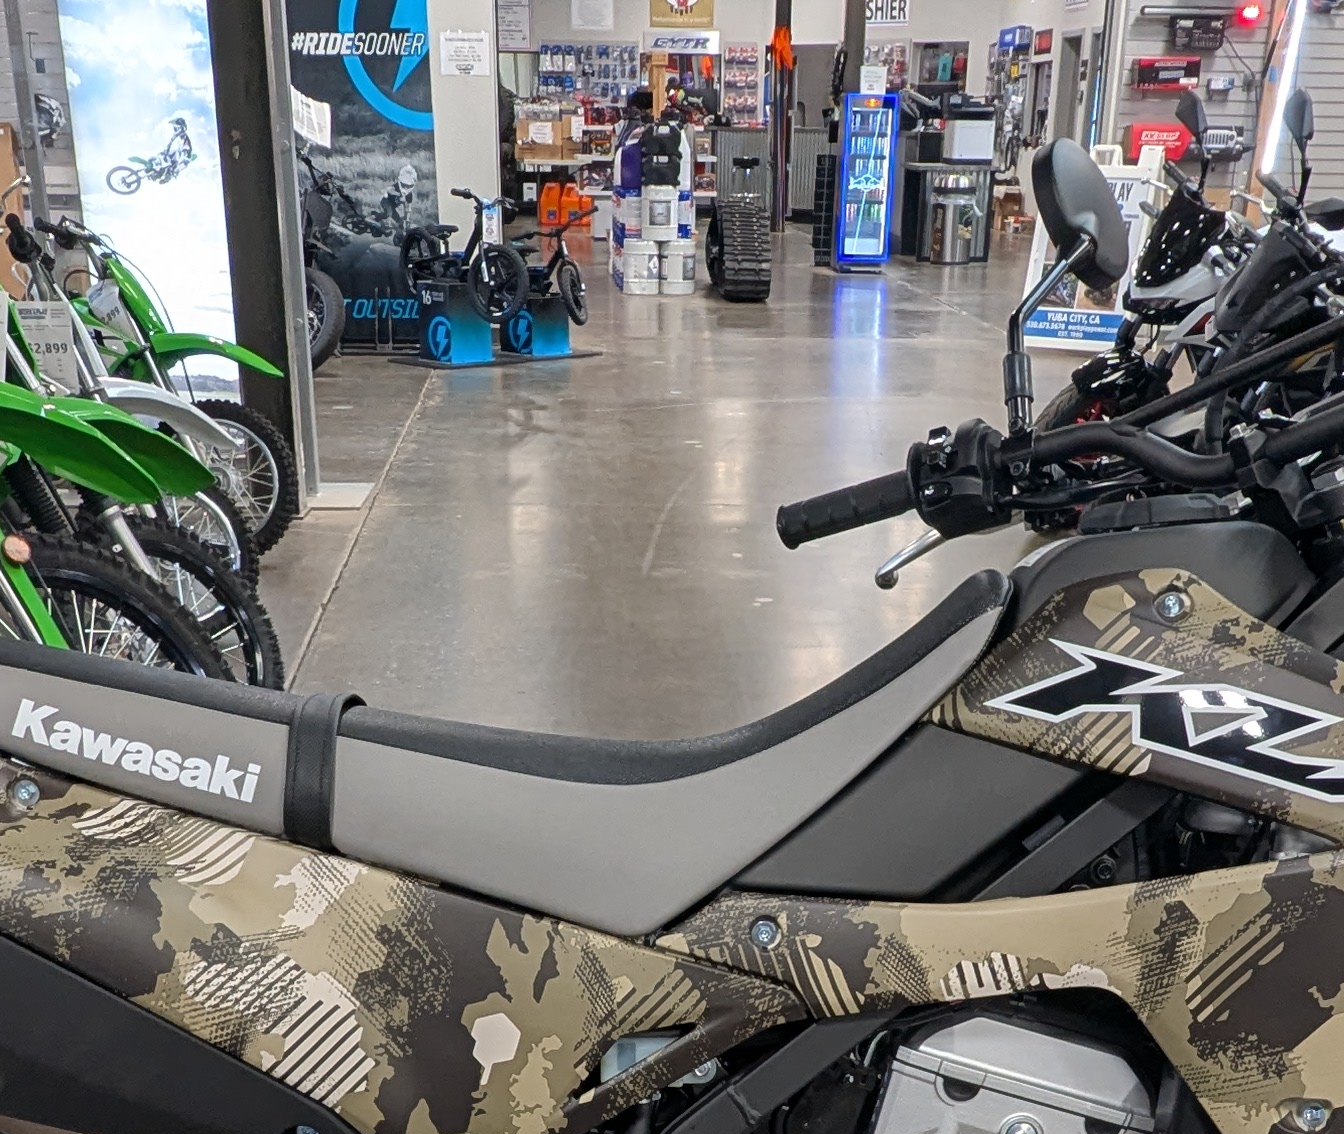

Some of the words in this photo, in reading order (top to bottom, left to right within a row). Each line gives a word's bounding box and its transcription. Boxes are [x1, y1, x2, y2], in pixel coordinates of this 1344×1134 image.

[291, 33, 425, 56] #RIDESOONER
[421, 290, 432, 305] 16
[11, 698, 262, 803] Kawasaki
